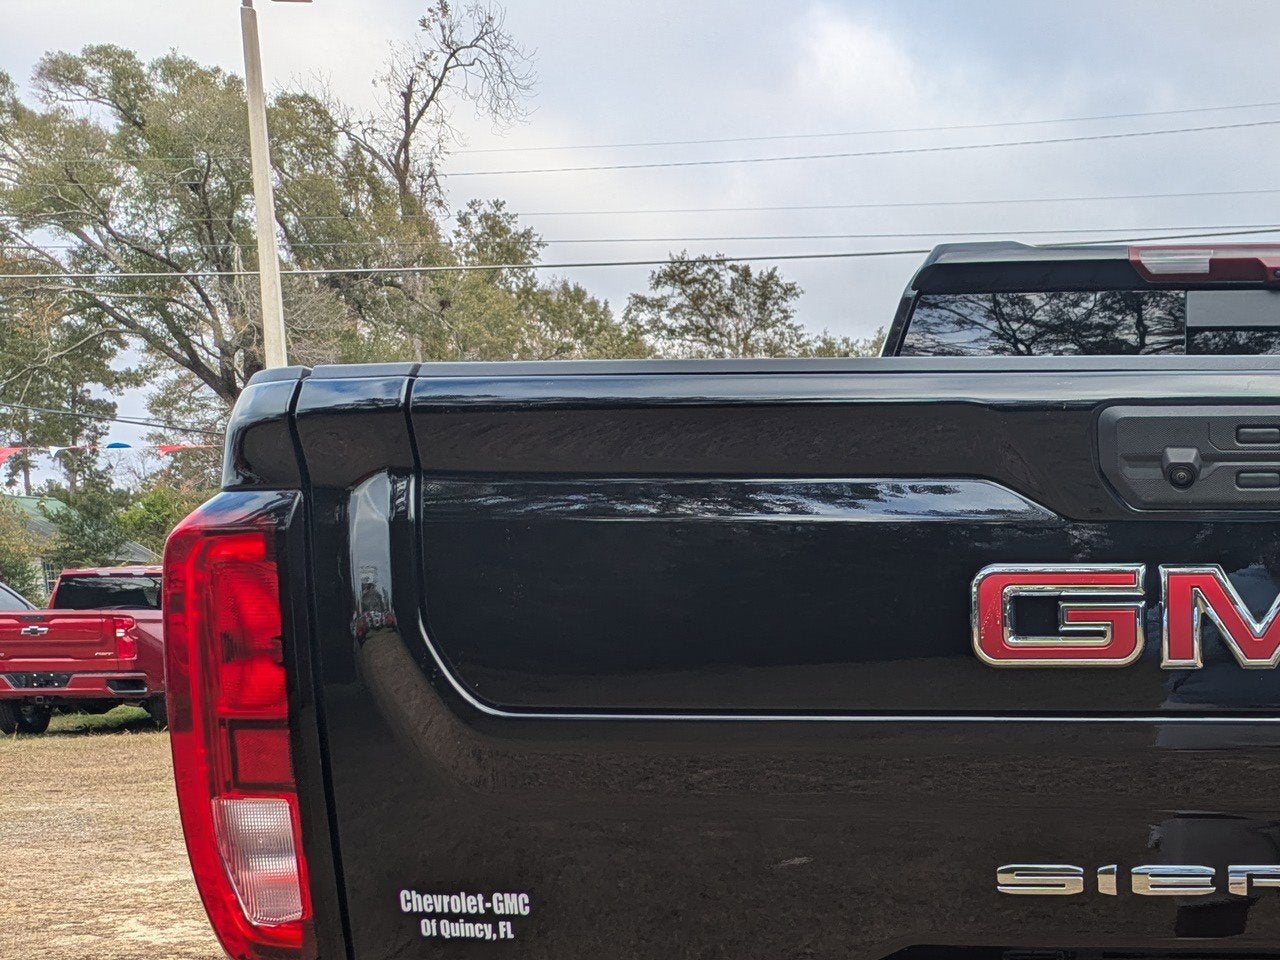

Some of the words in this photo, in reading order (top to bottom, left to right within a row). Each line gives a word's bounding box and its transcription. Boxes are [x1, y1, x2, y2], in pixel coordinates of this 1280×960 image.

[400, 889, 530, 916] Chevrolet-GMC
[420, 918, 437, 937] Of
[440, 919, 496, 941] Quincy,
[498, 921, 515, 939] FL
